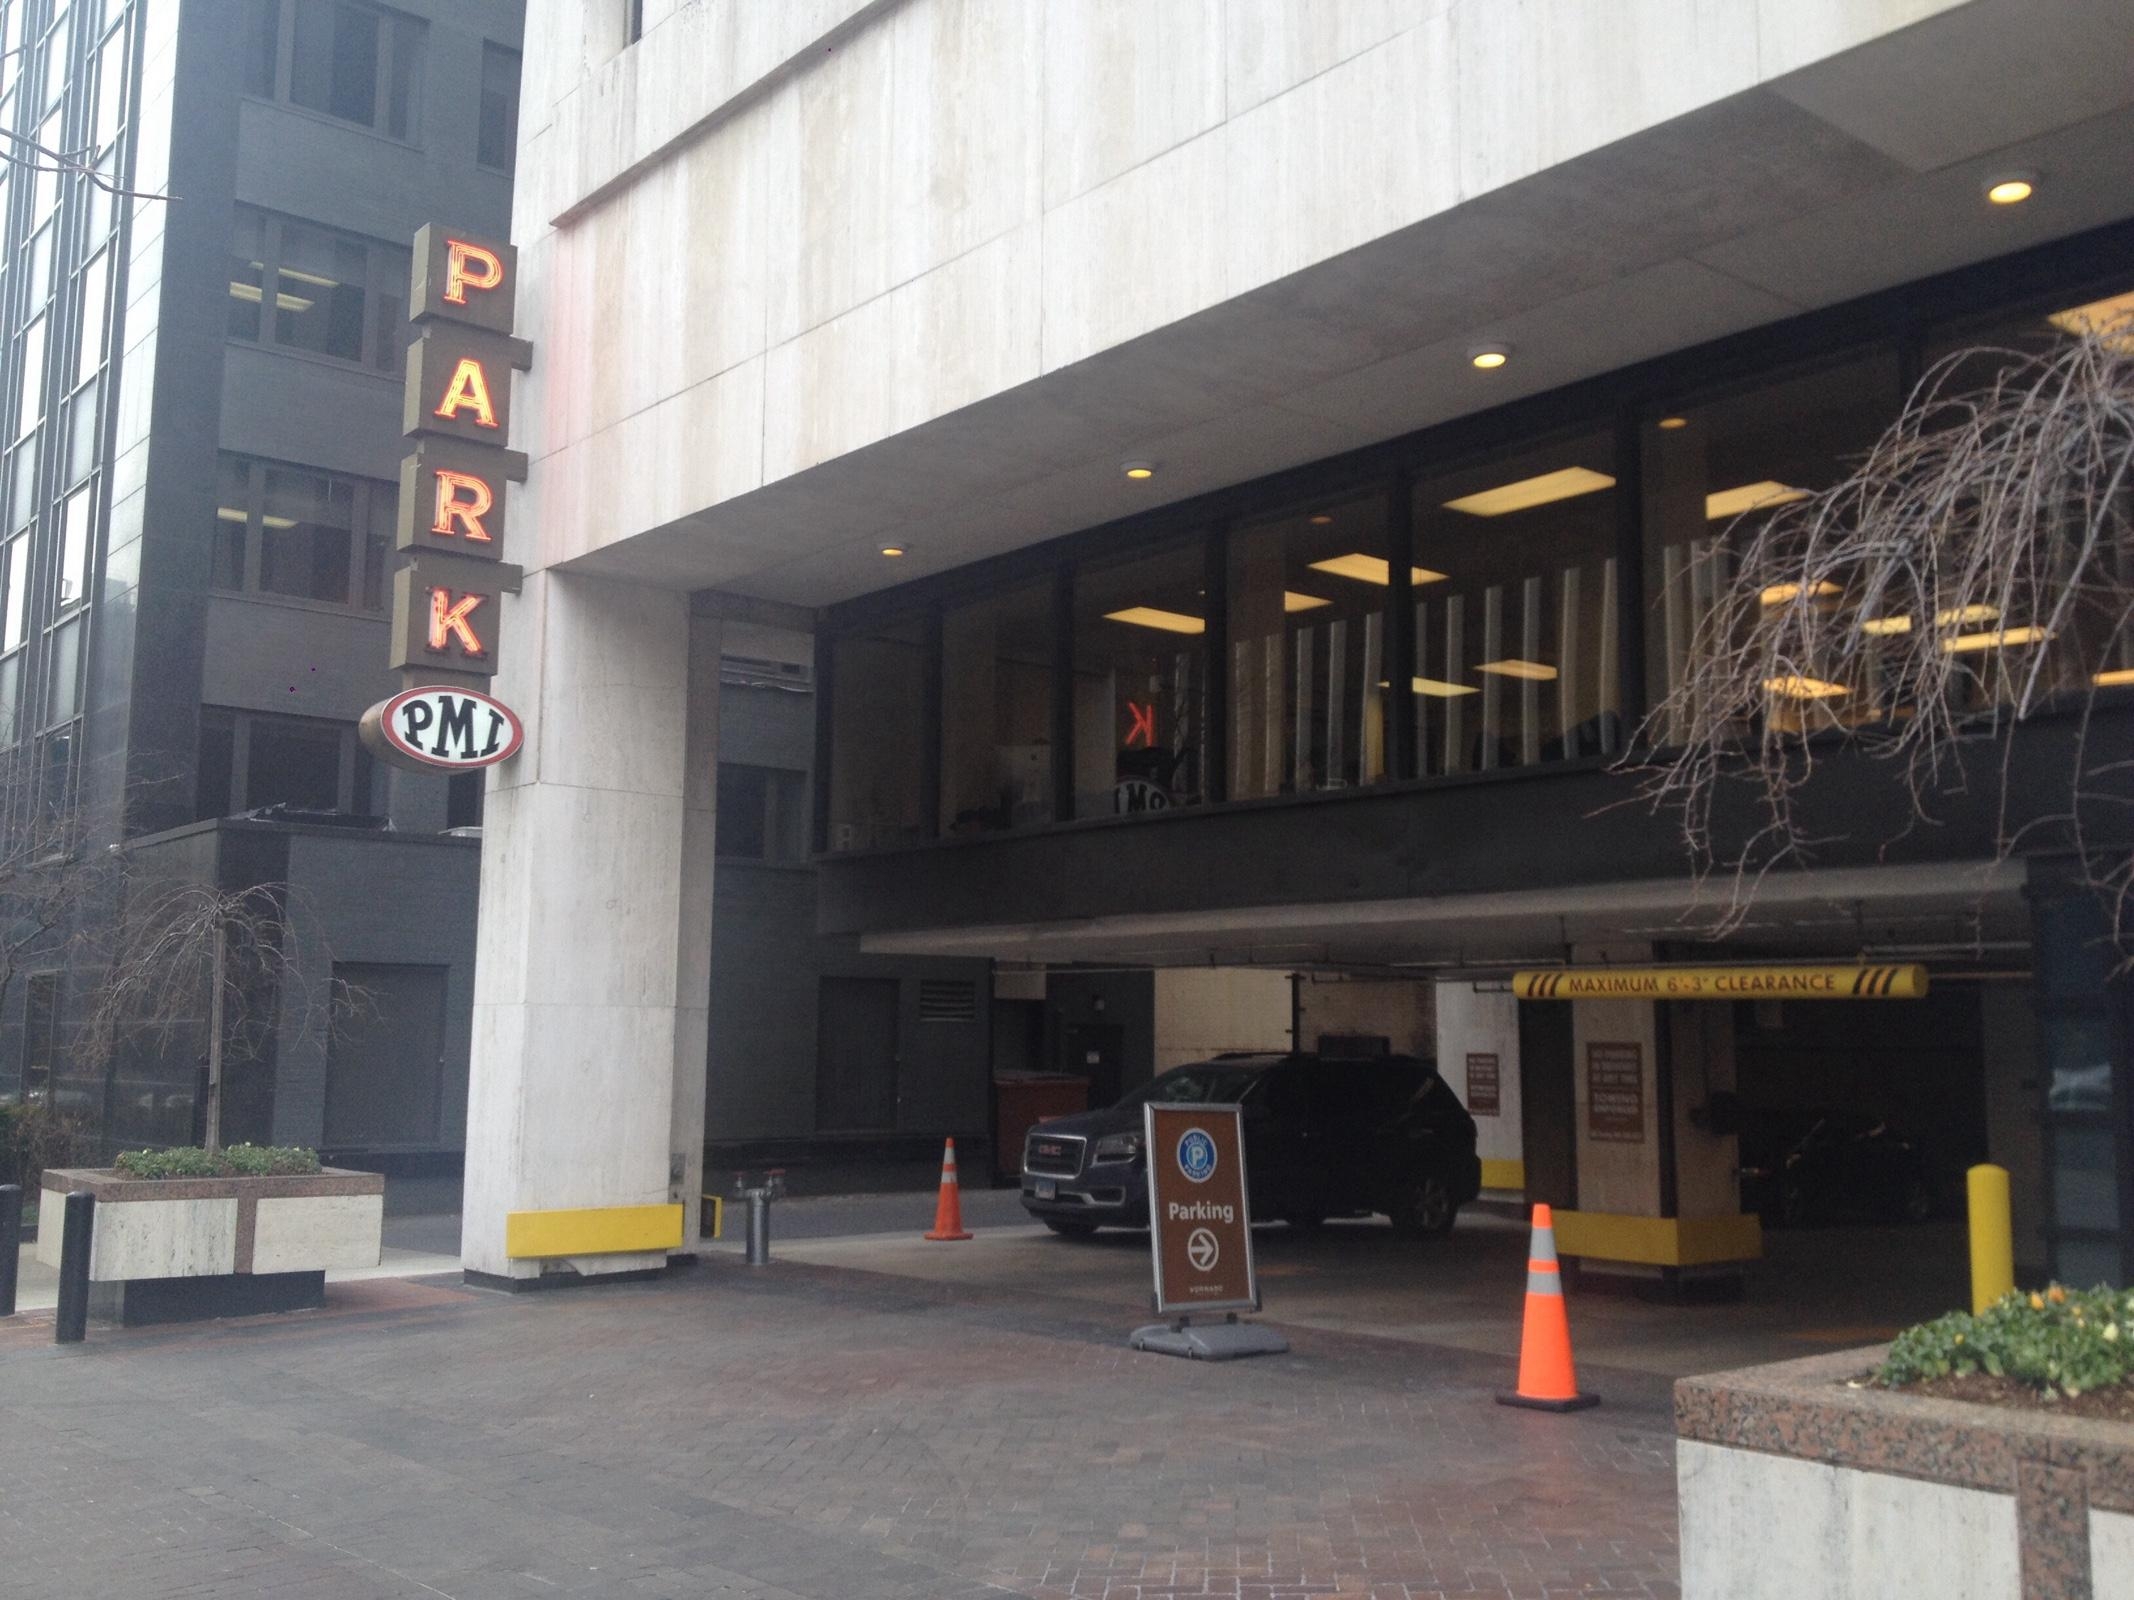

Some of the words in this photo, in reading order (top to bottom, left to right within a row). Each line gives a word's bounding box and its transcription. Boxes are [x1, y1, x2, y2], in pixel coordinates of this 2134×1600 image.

[426, 239, 504, 656] PARK
[402, 694, 505, 760] PMI
[1569, 975, 1660, 993] MAXIMUM
[1714, 973, 1836, 992] CLEARANCE
[1190, 1146, 1204, 1168] P
[1168, 1200, 1234, 1224] Parking
